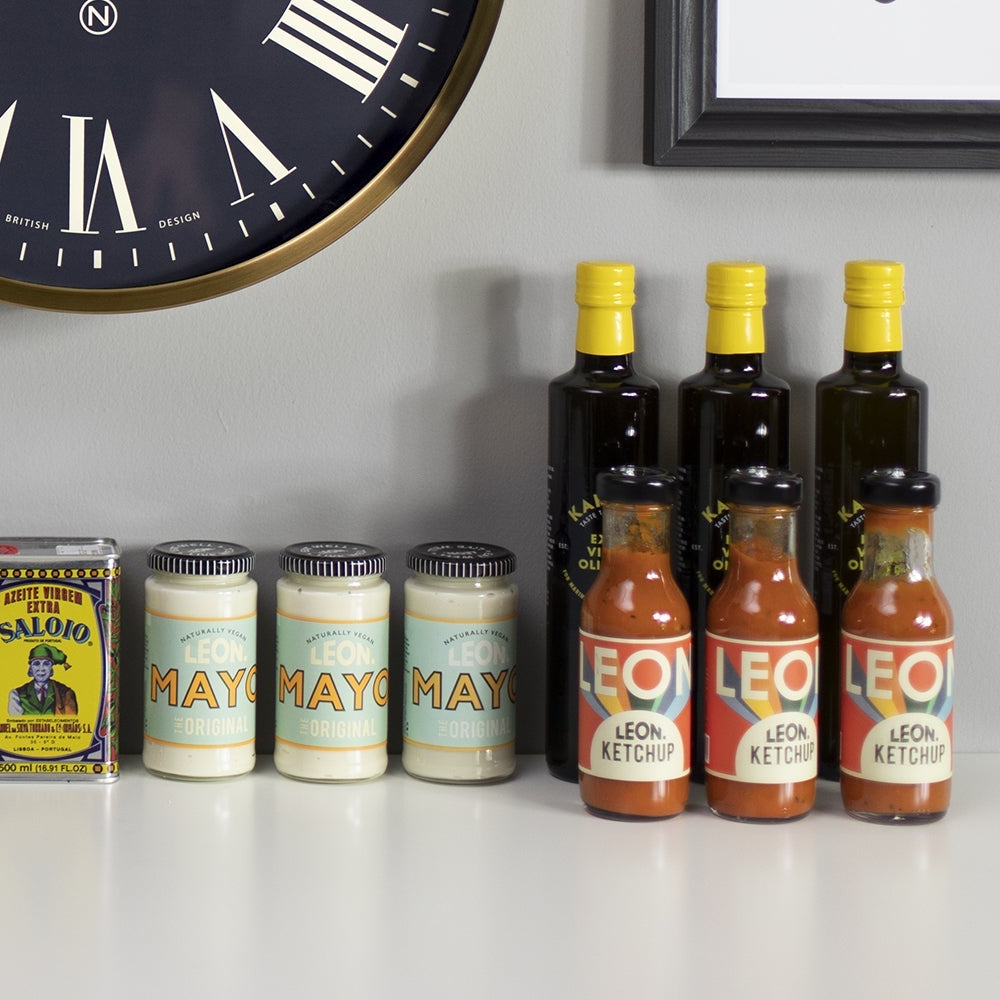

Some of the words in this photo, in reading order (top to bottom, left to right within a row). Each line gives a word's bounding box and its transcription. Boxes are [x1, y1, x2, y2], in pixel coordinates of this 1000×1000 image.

[210, 88, 297, 206] V
[60, 114, 147, 234] VI
[5, 213, 50, 231] BRITISH
[158, 211, 201, 229] DESIGN
[580, 512, 597, 528] TASTE
[4, 587, 39, 605] AZEITE
[43, 586, 83, 605] VIRGEM
[27, 600, 60, 614] EXTRA
[180, 628, 225, 643] NATURALLY
[227, 628, 247, 642] VEGAN
[306, 630, 351, 645] NATURALLY
[354, 631, 375, 645] VEGAN
[443, 629, 489, 646] NATURALLY
[491, 629, 509, 643] VEGAN
[184, 638, 248, 664] LEON.
[310, 640, 376, 666] LEON.
[716, 646, 819, 701] LEO
[279, 664, 389, 711] MAYO
[174, 717, 184, 734] THE
[185, 716, 249, 736] ORIGINAL
[299, 718, 309, 735] THE
[310, 719, 377, 738] ORIGINAL
[449, 719, 512, 738] ORIGINAL
[615, 721, 666, 740] LEON.
[766, 723, 810, 743] LEON.
[890, 724, 939, 743] LEON.
[602, 741, 675, 763] KETCHUP
[750, 742, 815, 765] KETCHUP
[875, 743, 945, 765] KETCHUP
[35, 764, 58, 773] (16.91
[61, 765, 87, 773] FL.OZ)
